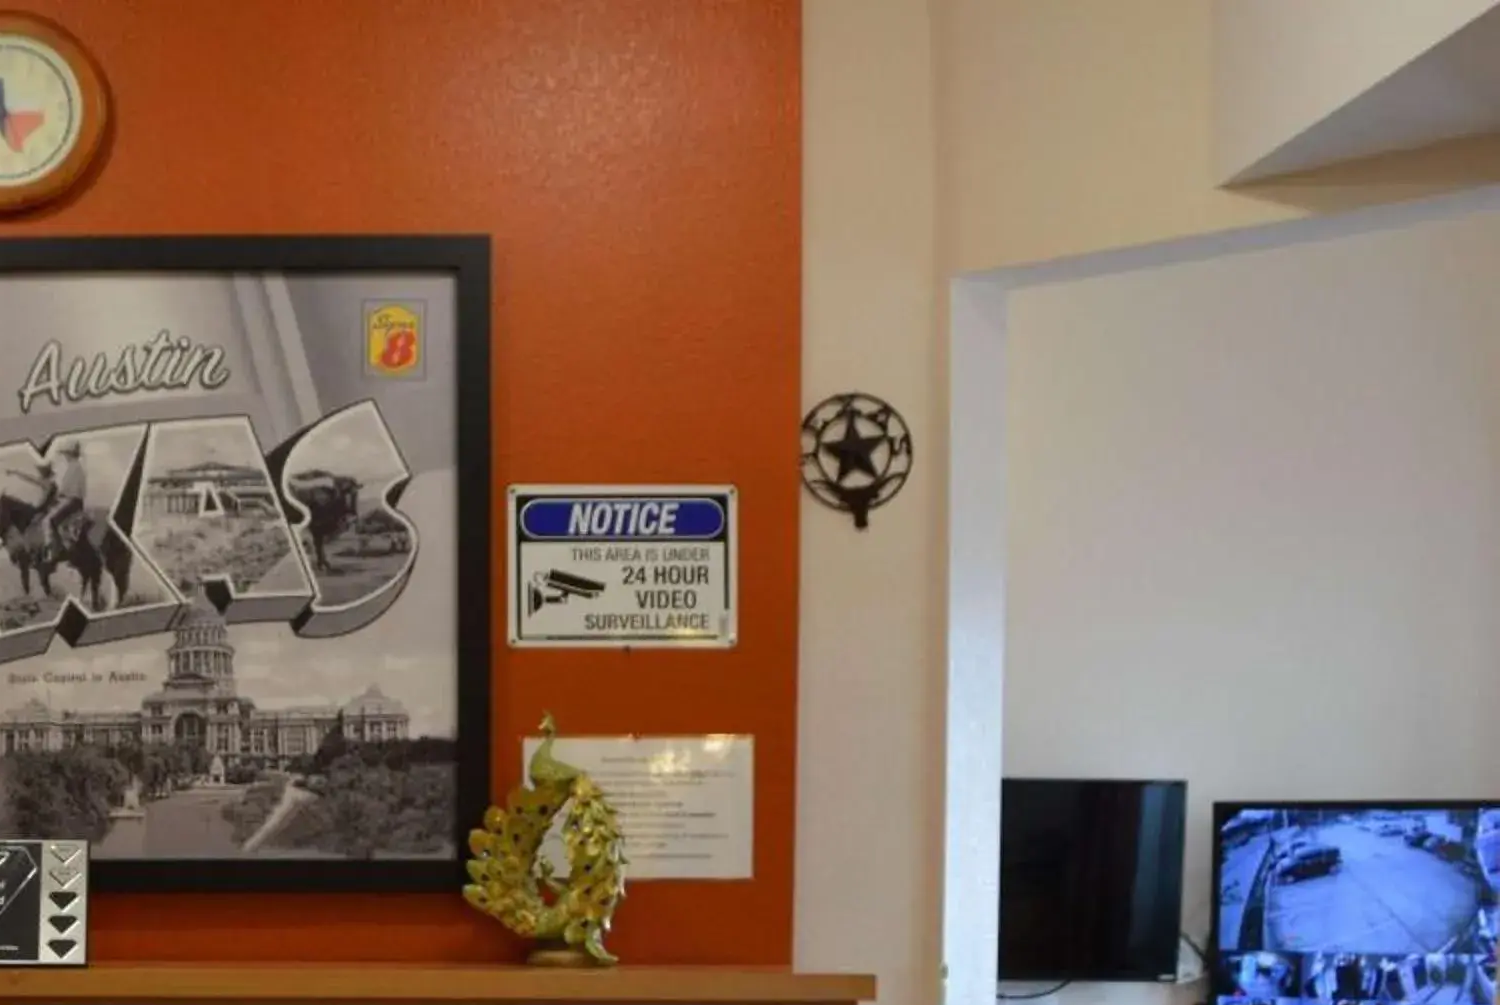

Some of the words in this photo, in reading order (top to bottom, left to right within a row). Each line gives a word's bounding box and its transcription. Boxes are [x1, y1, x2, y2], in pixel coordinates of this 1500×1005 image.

[380, 330, 415, 368] 8
[19, 329, 229, 415] Austin
[568, 503, 679, 535] NOTICE
[572, 548, 601, 561] THIS
[606, 548, 641, 561] AREA
[646, 548, 658, 561] IS
[663, 548, 710, 561] UNDER
[622, 566, 647, 585] 24
[654, 566, 709, 585] HOUR
[635, 590, 697, 609] VIDEO
[585, 614, 709, 630] SURVEILLANCE
